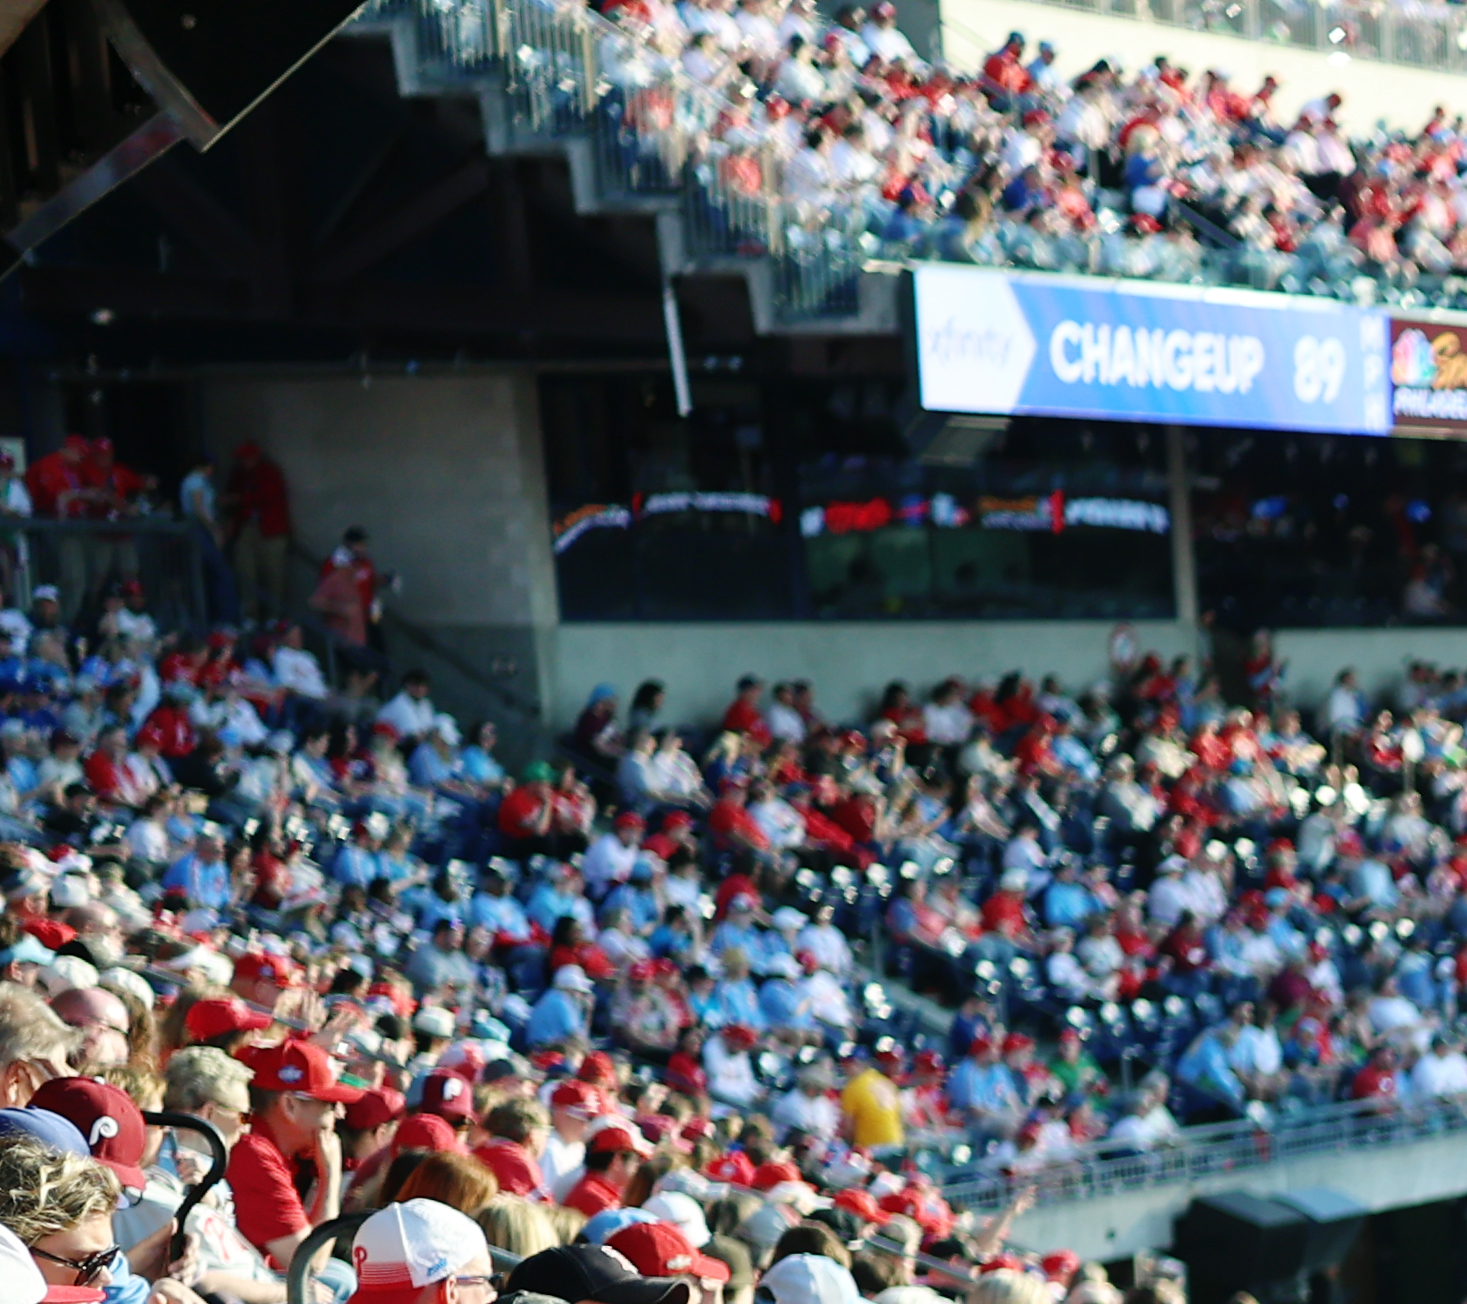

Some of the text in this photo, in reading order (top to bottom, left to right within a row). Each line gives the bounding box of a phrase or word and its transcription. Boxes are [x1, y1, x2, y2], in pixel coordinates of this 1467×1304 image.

[1049, 320, 1265, 394] CHANGEUP
[1293, 335, 1346, 403] 89
[89, 1114, 119, 1146] P
[352, 1246, 368, 1276] P
